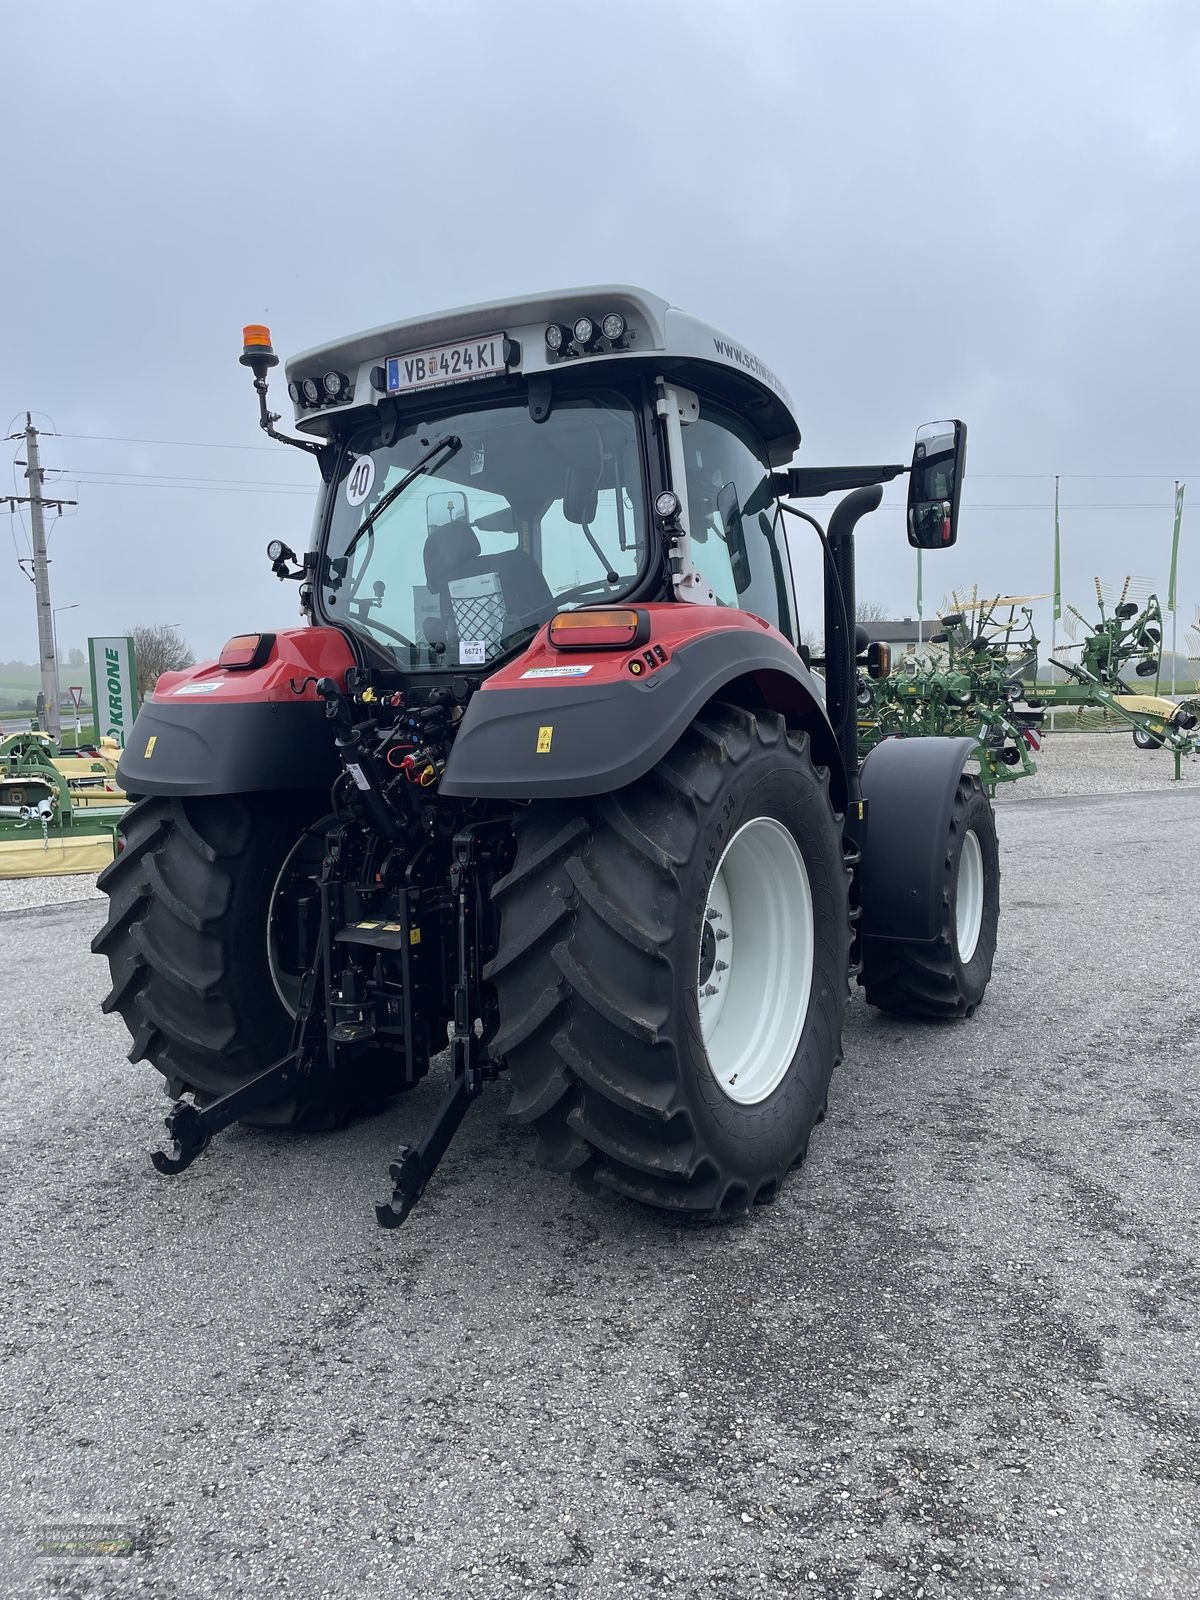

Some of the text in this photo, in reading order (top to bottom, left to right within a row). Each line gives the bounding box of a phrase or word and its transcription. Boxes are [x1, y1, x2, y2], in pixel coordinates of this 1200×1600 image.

[404, 358, 426, 383] VB
[350, 463, 371, 498] 40
[464, 647, 482, 655] 66721
[105, 647, 124, 727] KRONE
